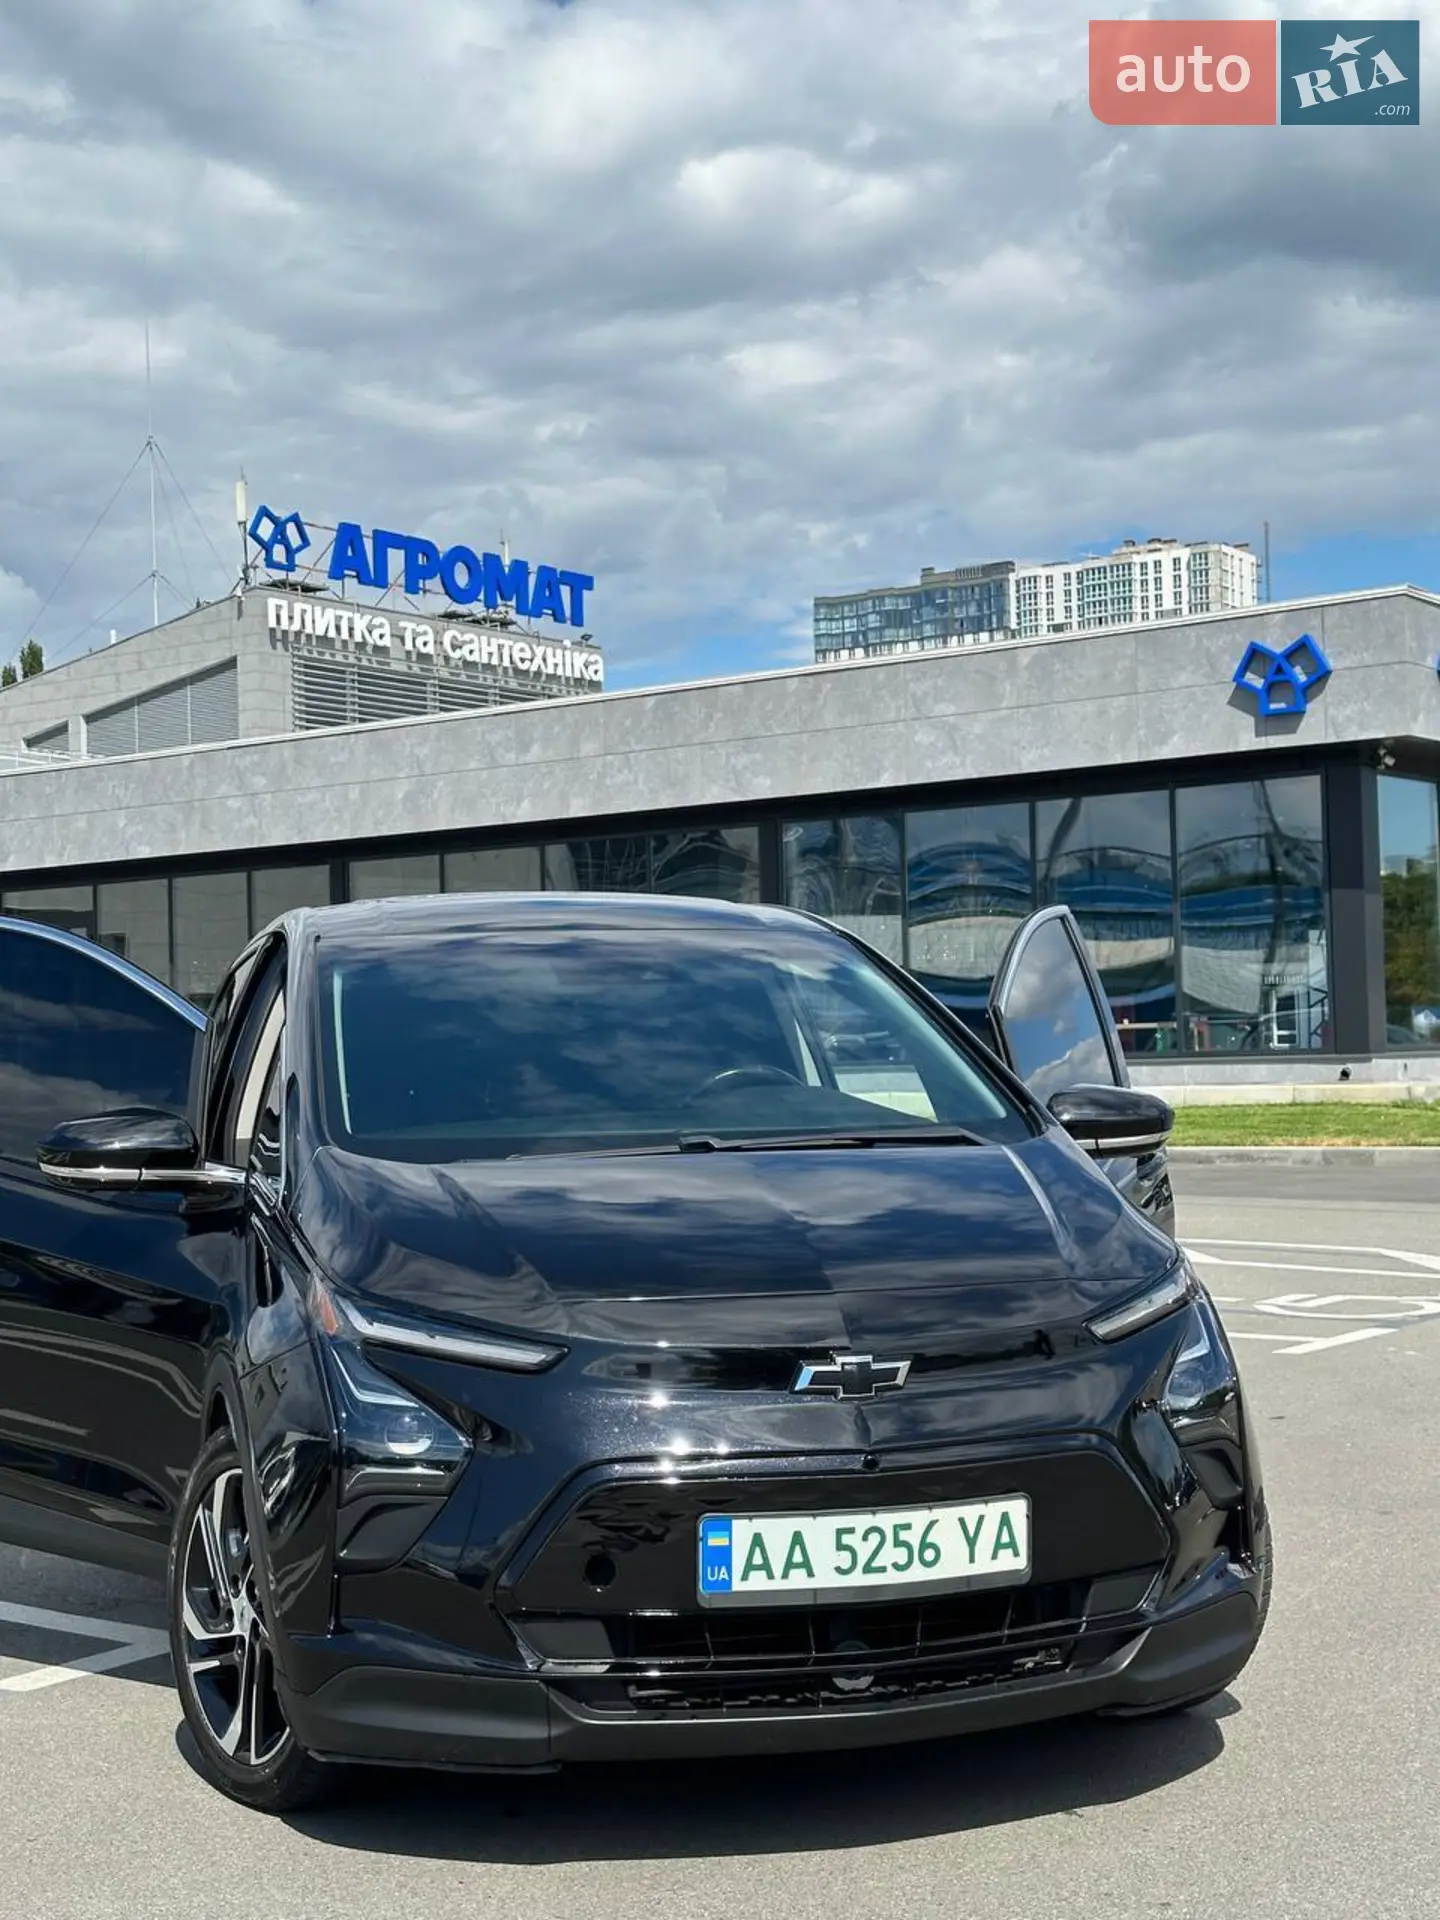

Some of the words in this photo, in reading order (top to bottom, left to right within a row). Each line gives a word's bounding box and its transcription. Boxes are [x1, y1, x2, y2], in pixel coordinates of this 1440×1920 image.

[328, 521, 594, 626] АГРОМАТ
[400, 620, 435, 655] та
[443, 627, 604, 682] сантехніка
[707, 1565, 729, 1581] UA
[740, 1531, 815, 1581] AA
[834, 1519, 942, 1575] 5256
[958, 1511, 1020, 1564] YA
